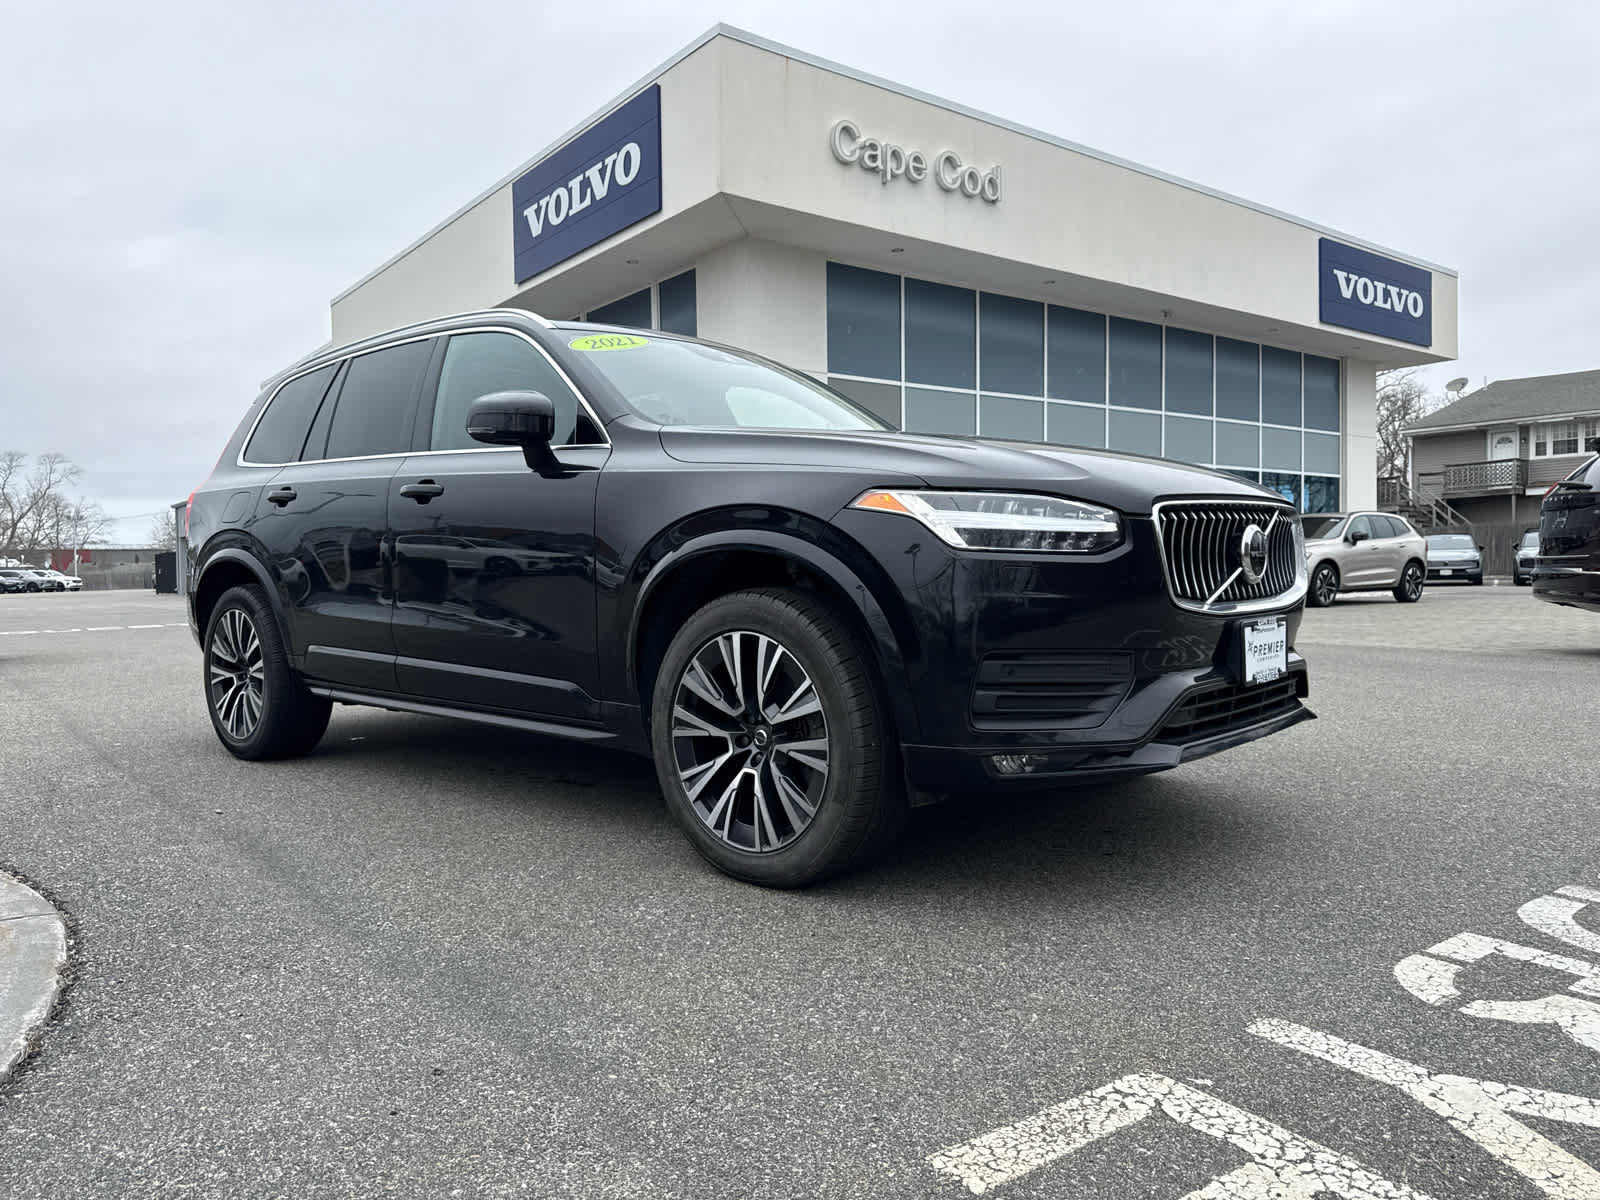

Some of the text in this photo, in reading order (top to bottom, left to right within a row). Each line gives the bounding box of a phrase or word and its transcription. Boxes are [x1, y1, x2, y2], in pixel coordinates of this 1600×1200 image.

[830, 119, 1003, 205] Cape Cod
[523, 142, 641, 238] VOLVO
[1333, 268, 1424, 318] VOLVO
[585, 336, 638, 350] 2021
[1253, 640, 1285, 657] PREMIER
